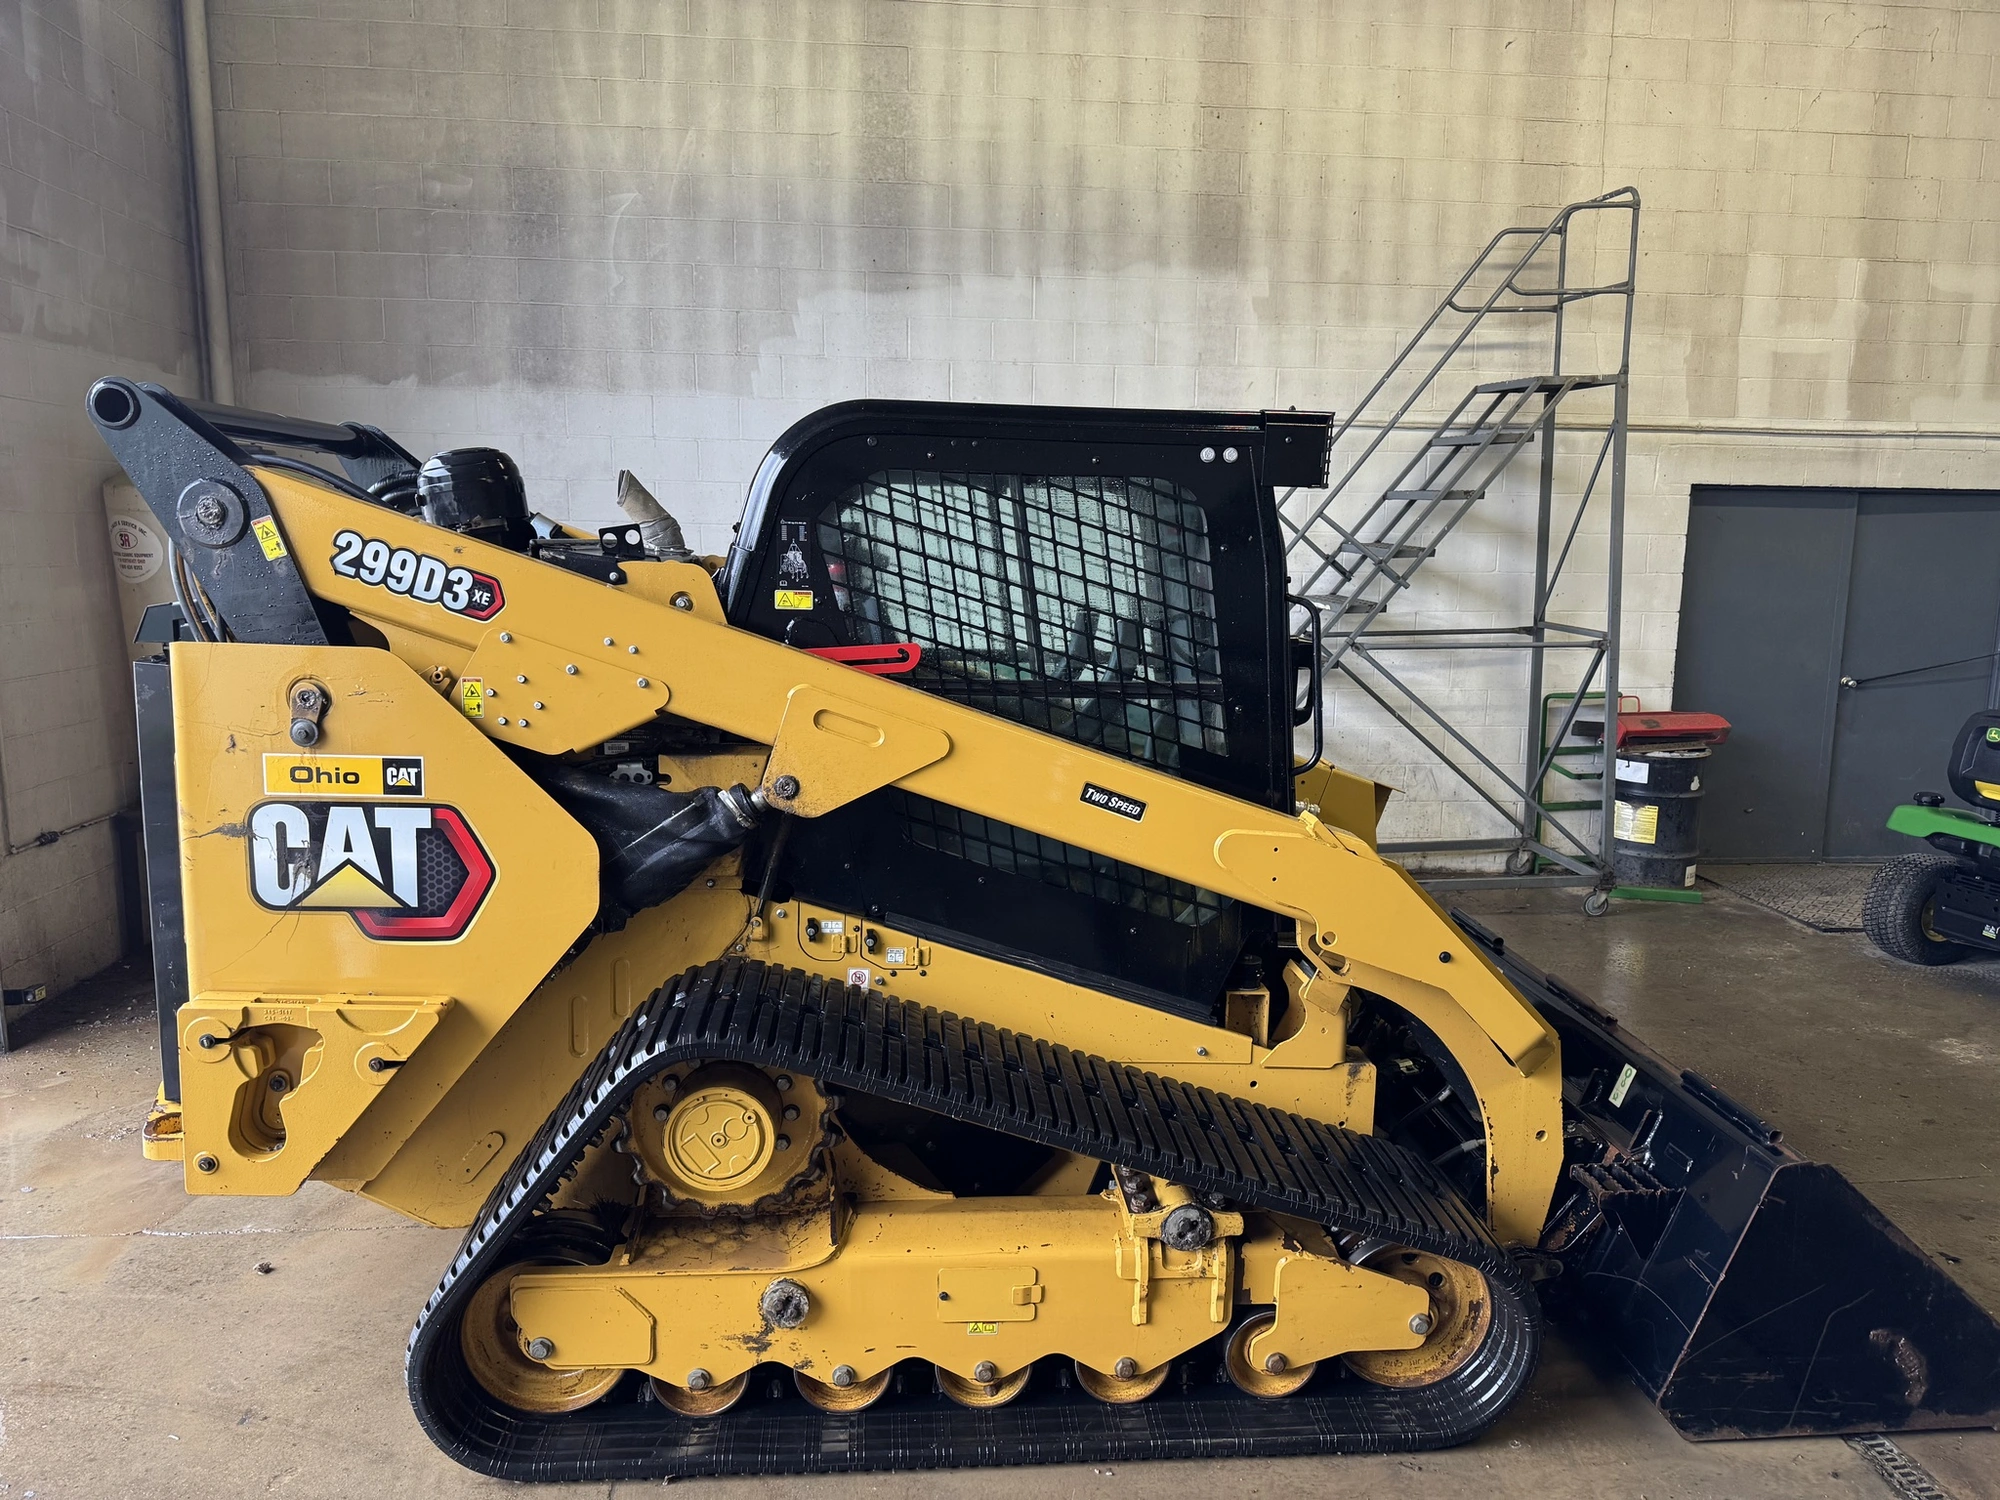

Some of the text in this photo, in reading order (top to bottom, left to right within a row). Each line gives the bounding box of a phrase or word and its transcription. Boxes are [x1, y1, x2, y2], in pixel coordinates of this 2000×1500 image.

[333, 532, 491, 610] 299D3 XE
[289, 766, 419, 787] Ohio CAT
[251, 804, 432, 908] CAT
